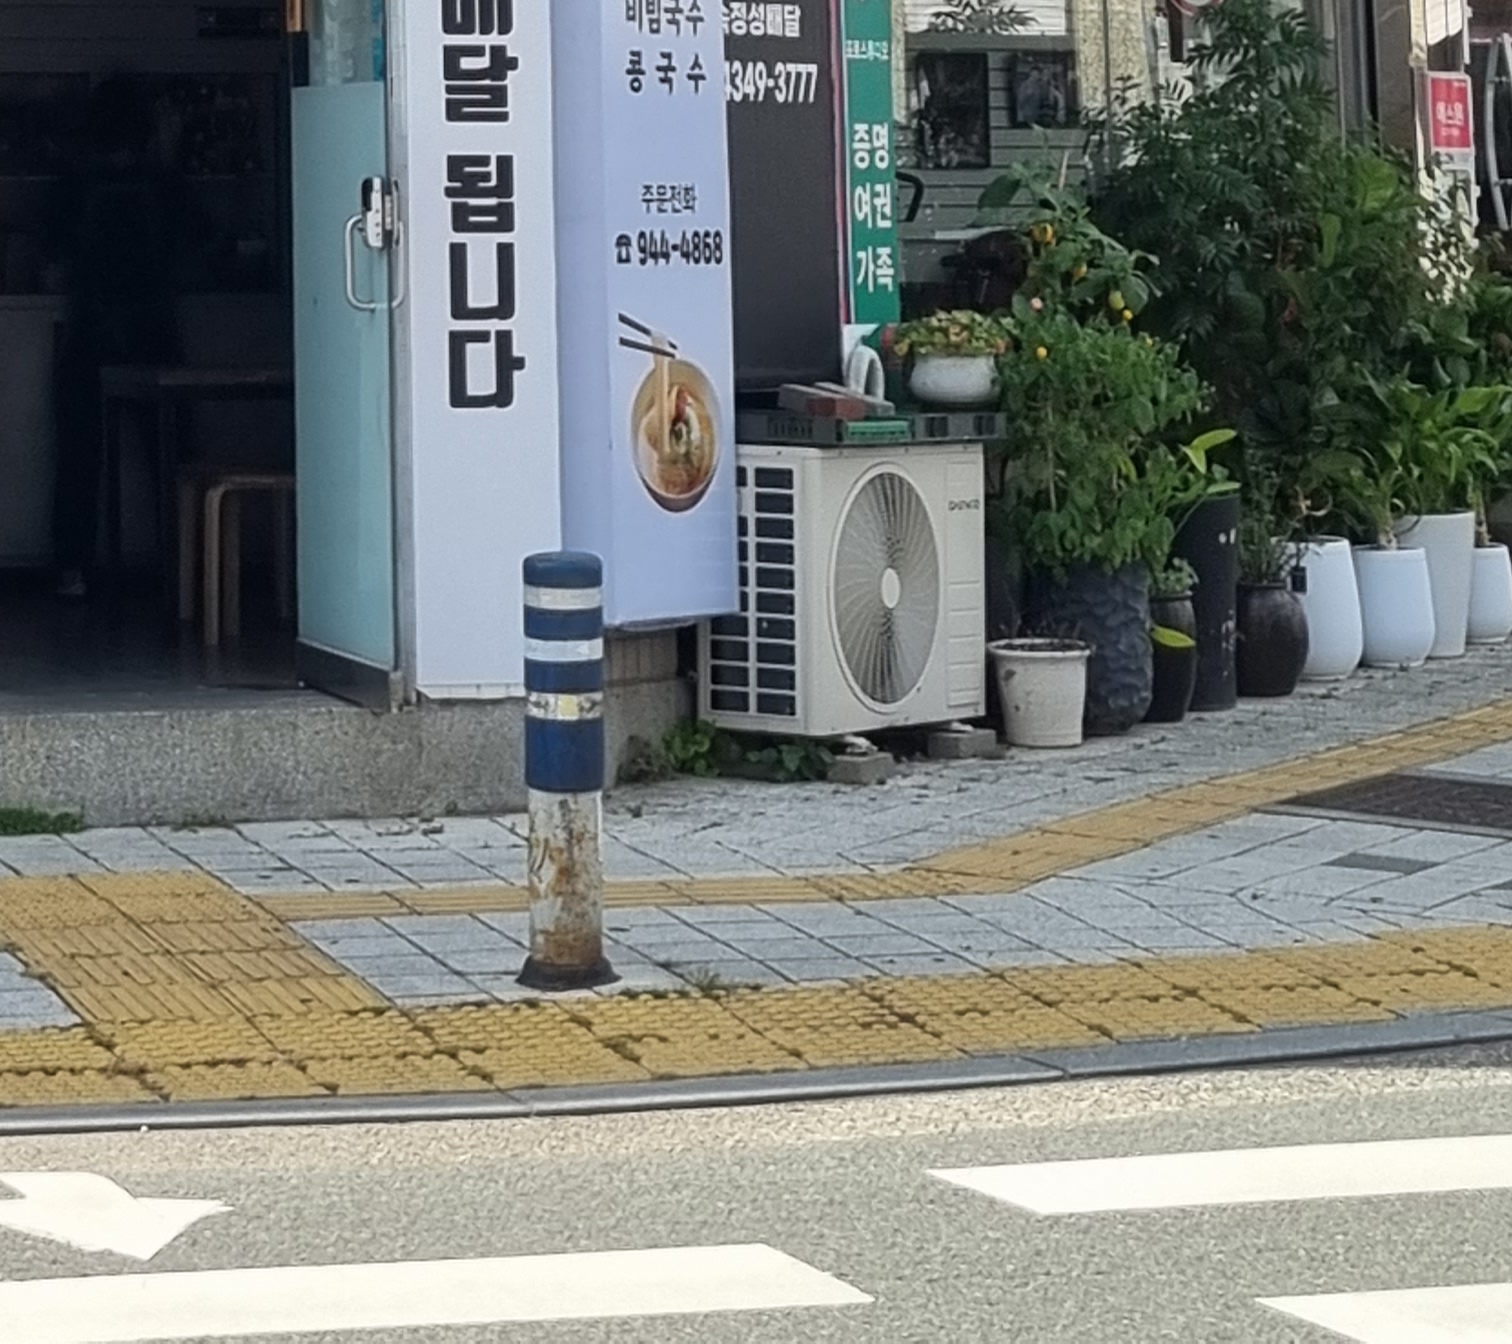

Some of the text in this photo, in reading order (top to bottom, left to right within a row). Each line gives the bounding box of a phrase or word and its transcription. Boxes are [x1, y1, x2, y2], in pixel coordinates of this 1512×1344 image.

[625, 49, 708, 95] 콩국수
[852, 122, 890, 170] 증명
[640, 183, 697, 215] 주문전화
[854, 181, 893, 230] 여권
[636, 229, 724, 267] 944-4868
[856, 245, 895, 294] 가족
[442, 153, 527, 410] 됩니다
